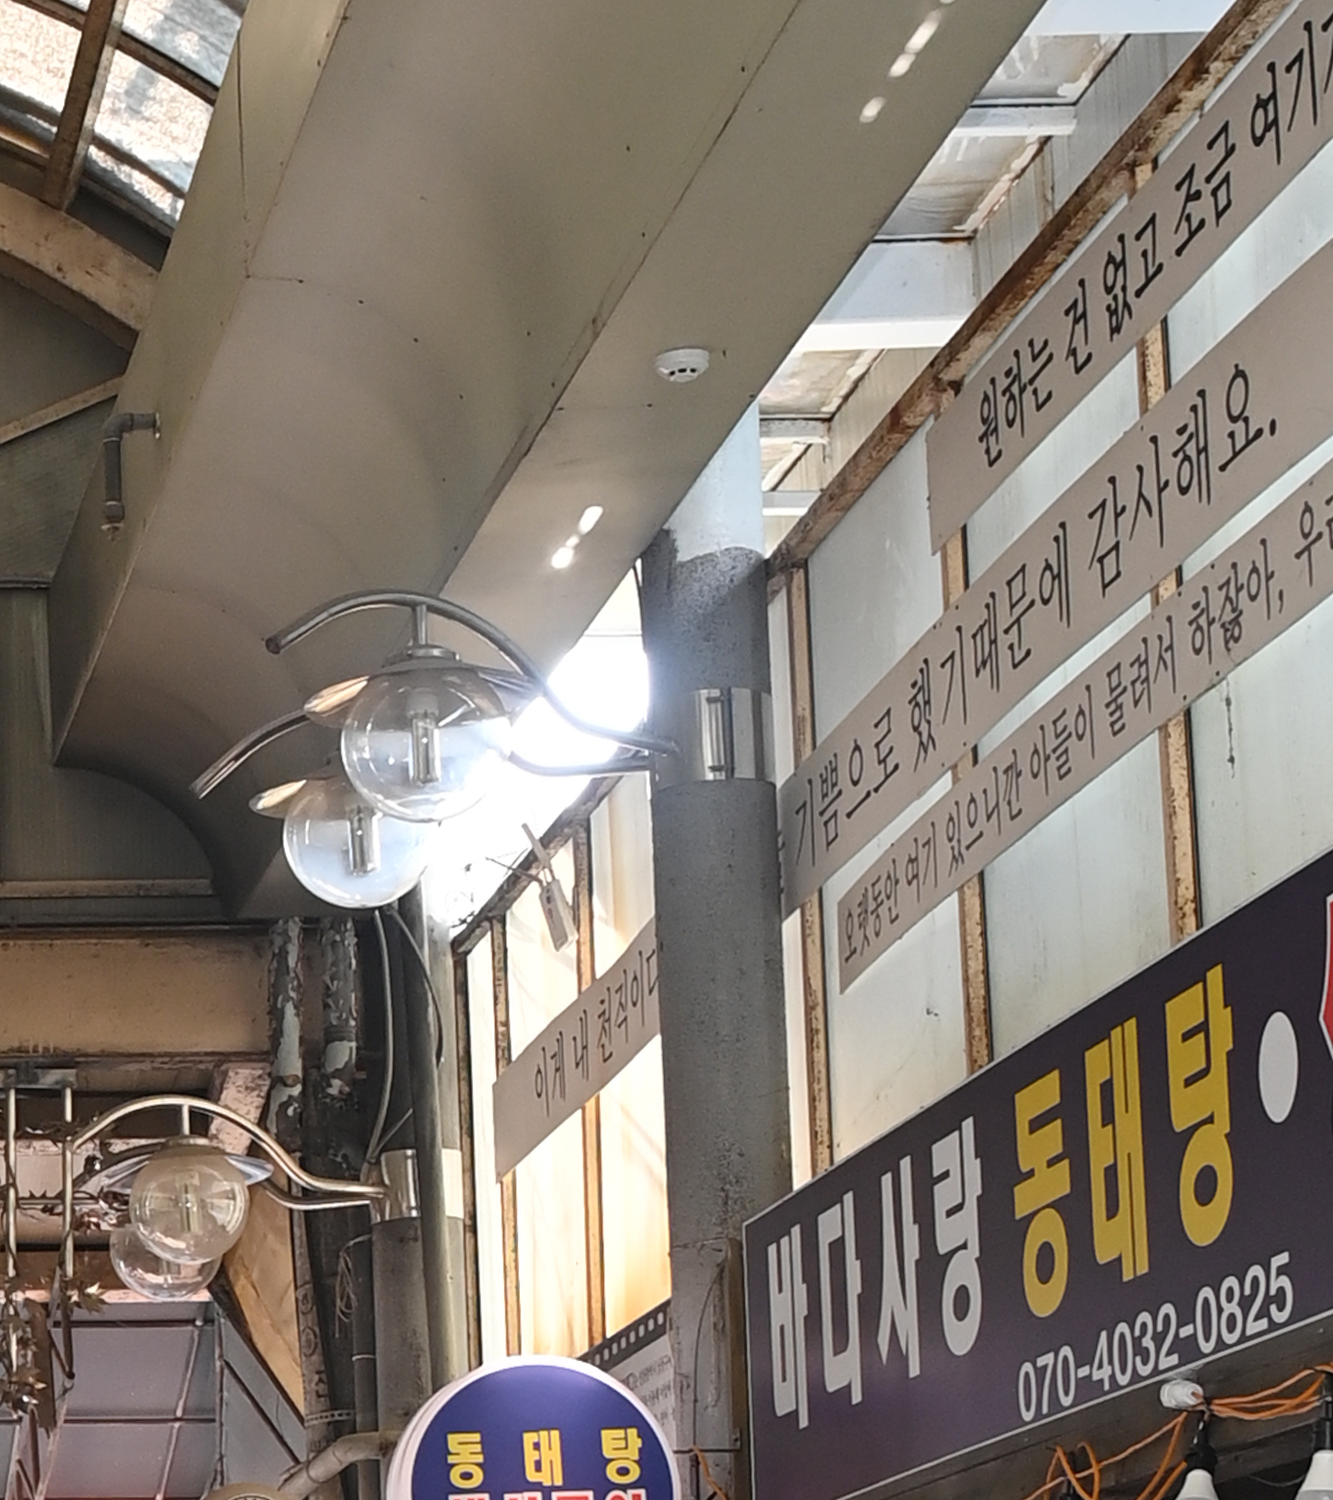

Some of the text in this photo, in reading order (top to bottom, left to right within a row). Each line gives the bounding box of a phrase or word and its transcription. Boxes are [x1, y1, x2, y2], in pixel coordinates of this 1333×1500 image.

[976, 338, 1054, 468] 원하는
[1064, 278, 1093, 376] 건
[1102, 213, 1164, 342] 없고
[1174, 119, 1236, 258] 조금
[794, 706, 900, 868] 기쁨으로
[1087, 363, 1278, 597] 감사해요.
[904, 820, 939, 904] 여기
[946, 748, 1024, 878] 있으니깐
[1029, 683, 1096, 798] 아들이
[1104, 614, 1177, 738] 물려서
[534, 1030, 566, 1118] 이게
[571, 1007, 590, 1083] 내
[766, 962, 1235, 1429] 바다사랑 동태탕
[1017, 1250, 1295, 1423] 070-4032-0825
